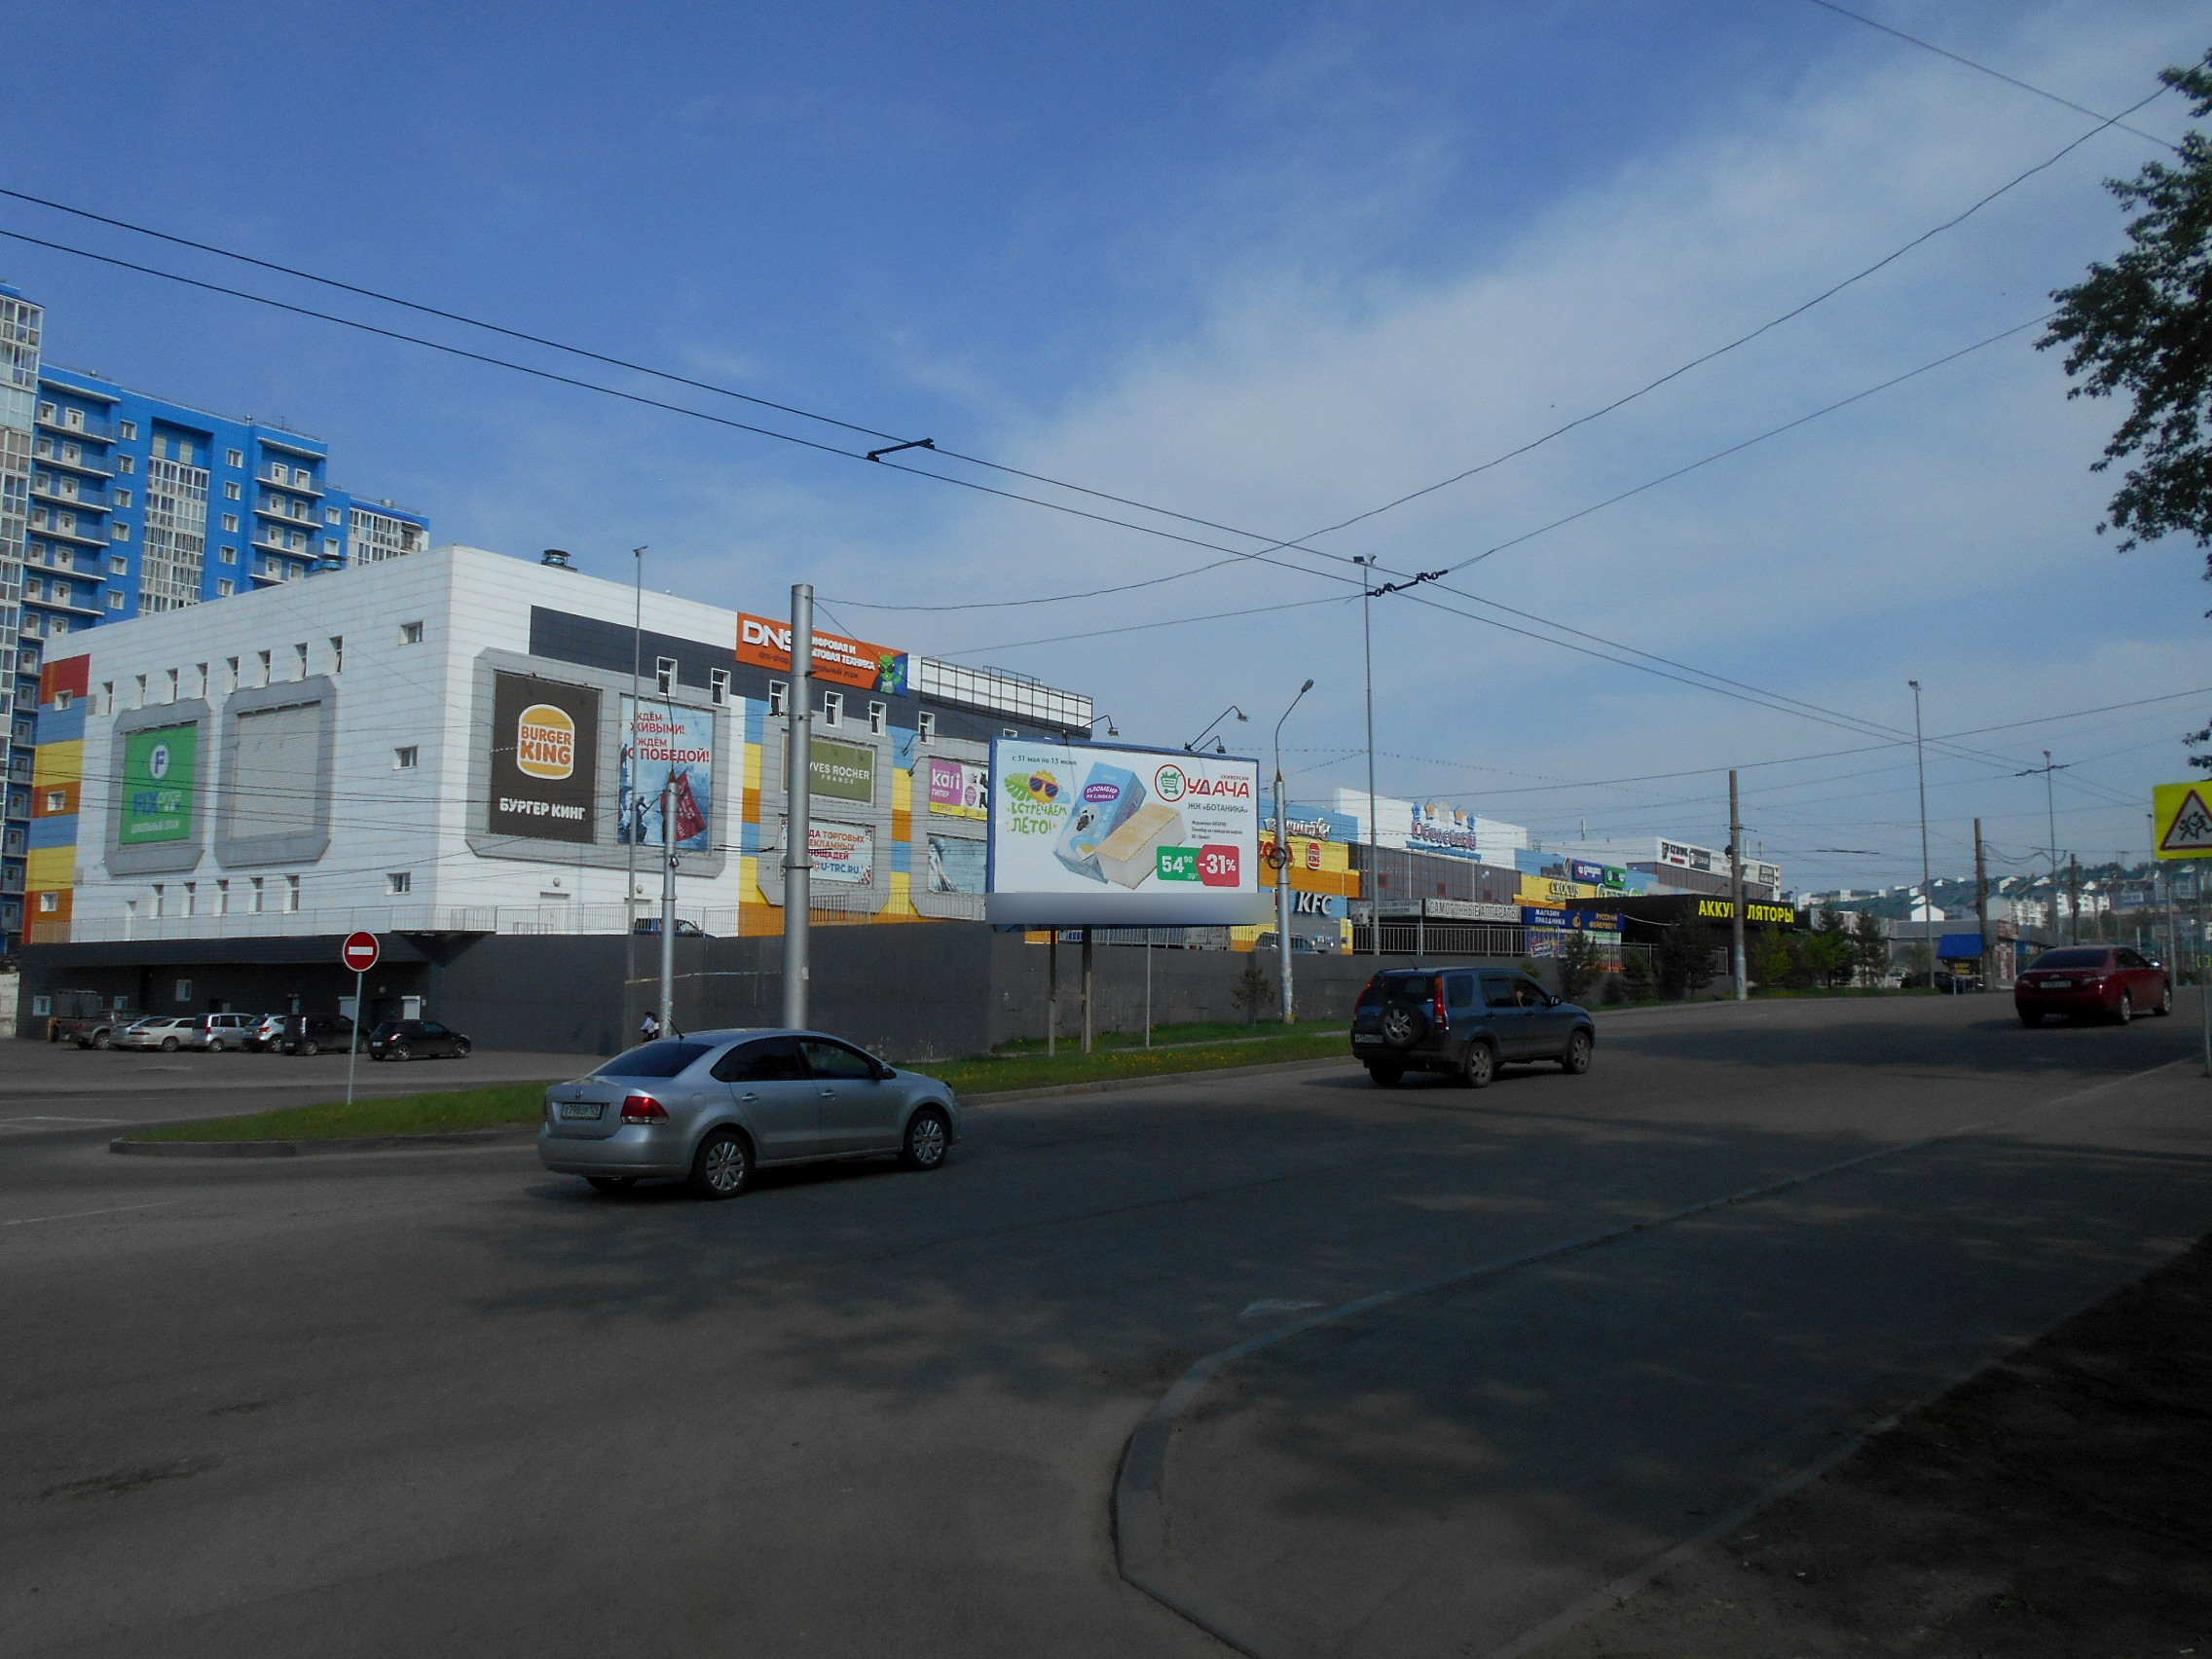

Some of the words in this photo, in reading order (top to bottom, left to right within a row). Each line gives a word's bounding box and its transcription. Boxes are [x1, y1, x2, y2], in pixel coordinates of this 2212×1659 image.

[743, 619, 792, 653] DNS
[812, 636, 848, 653] ИФРОВАЯ
[521, 725, 572, 746] BURGER
[637, 736, 667, 748] ЖДЁМ
[520, 739, 572, 765] KING
[641, 747, 710, 762] ПОБЕДОЙ!
[155, 750, 166, 775] F
[809, 761, 830, 774] YVES
[832, 765, 870, 781] ROCHER
[821, 774, 854, 785] FRANCE
[1187, 778, 1250, 798] УДАЧА
[1087, 786, 1119, 794] ПЛОМБИР
[499, 797, 550, 816] БУРГЕР
[551, 803, 586, 820] КИНГ
[1011, 801, 1067, 817] ВСТРЕЧАЕМ
[1011, 816, 1051, 834] ЛЕТО!
[823, 830, 865, 843] ТОРГОВЫХ
[1412, 819, 1478, 851] Юбилейный
[809, 838, 855, 852] ЕКЛАМНЫХ
[1198, 853, 1236, 874] -31%
[1550, 879, 1579, 897] CROCUS
[1297, 891, 1333, 915] KFC
[1429, 901, 1480, 917] САМОГОННЫЕ
[1480, 905, 1517, 920] АППАРАТЫ
[1698, 900, 1794, 923] АККУЛЯТОРЫ
[1534, 908, 1560, 917] МАГАЗИН
[1534, 916, 1566, 925] ПРАЗДНИКА
